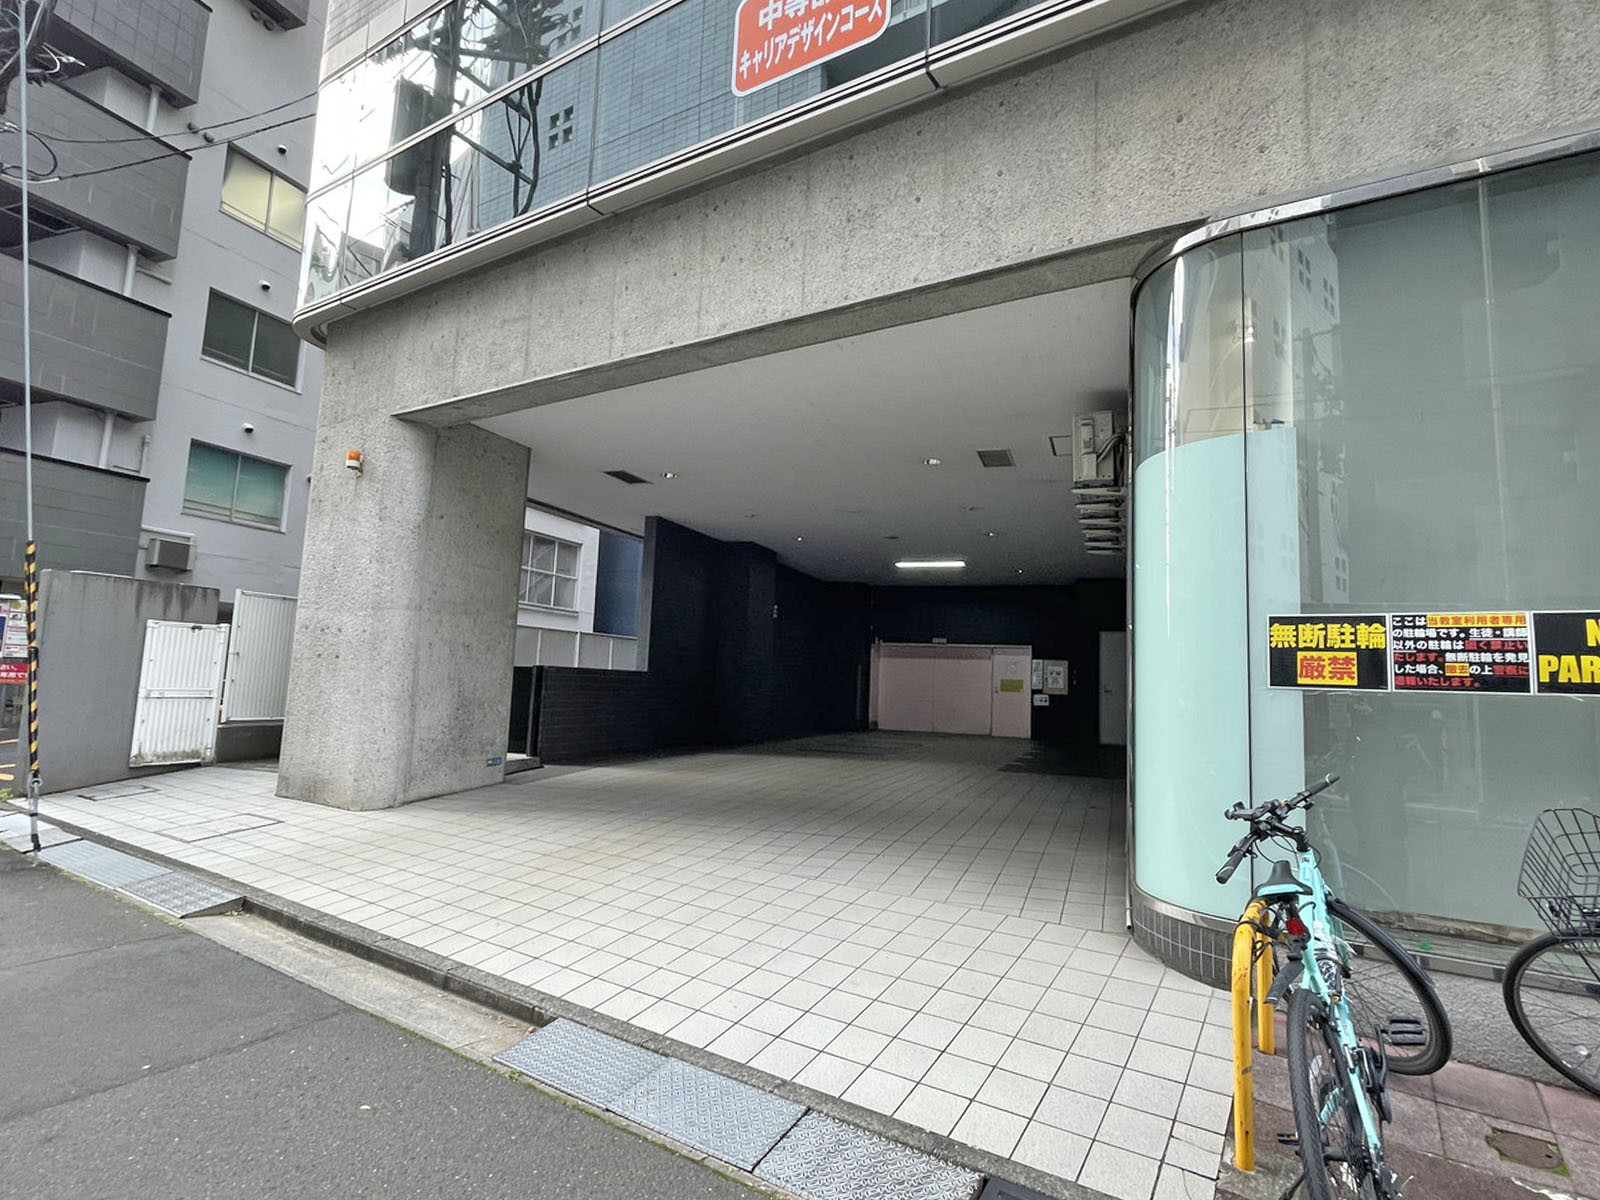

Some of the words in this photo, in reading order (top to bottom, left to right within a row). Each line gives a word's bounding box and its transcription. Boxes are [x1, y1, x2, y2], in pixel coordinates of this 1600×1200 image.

[739, 0, 883, 79] キャリアデザインコース
[1270, 623, 1386, 648] 無断駐輪
[1299, 656, 1355, 680] 厳禁
